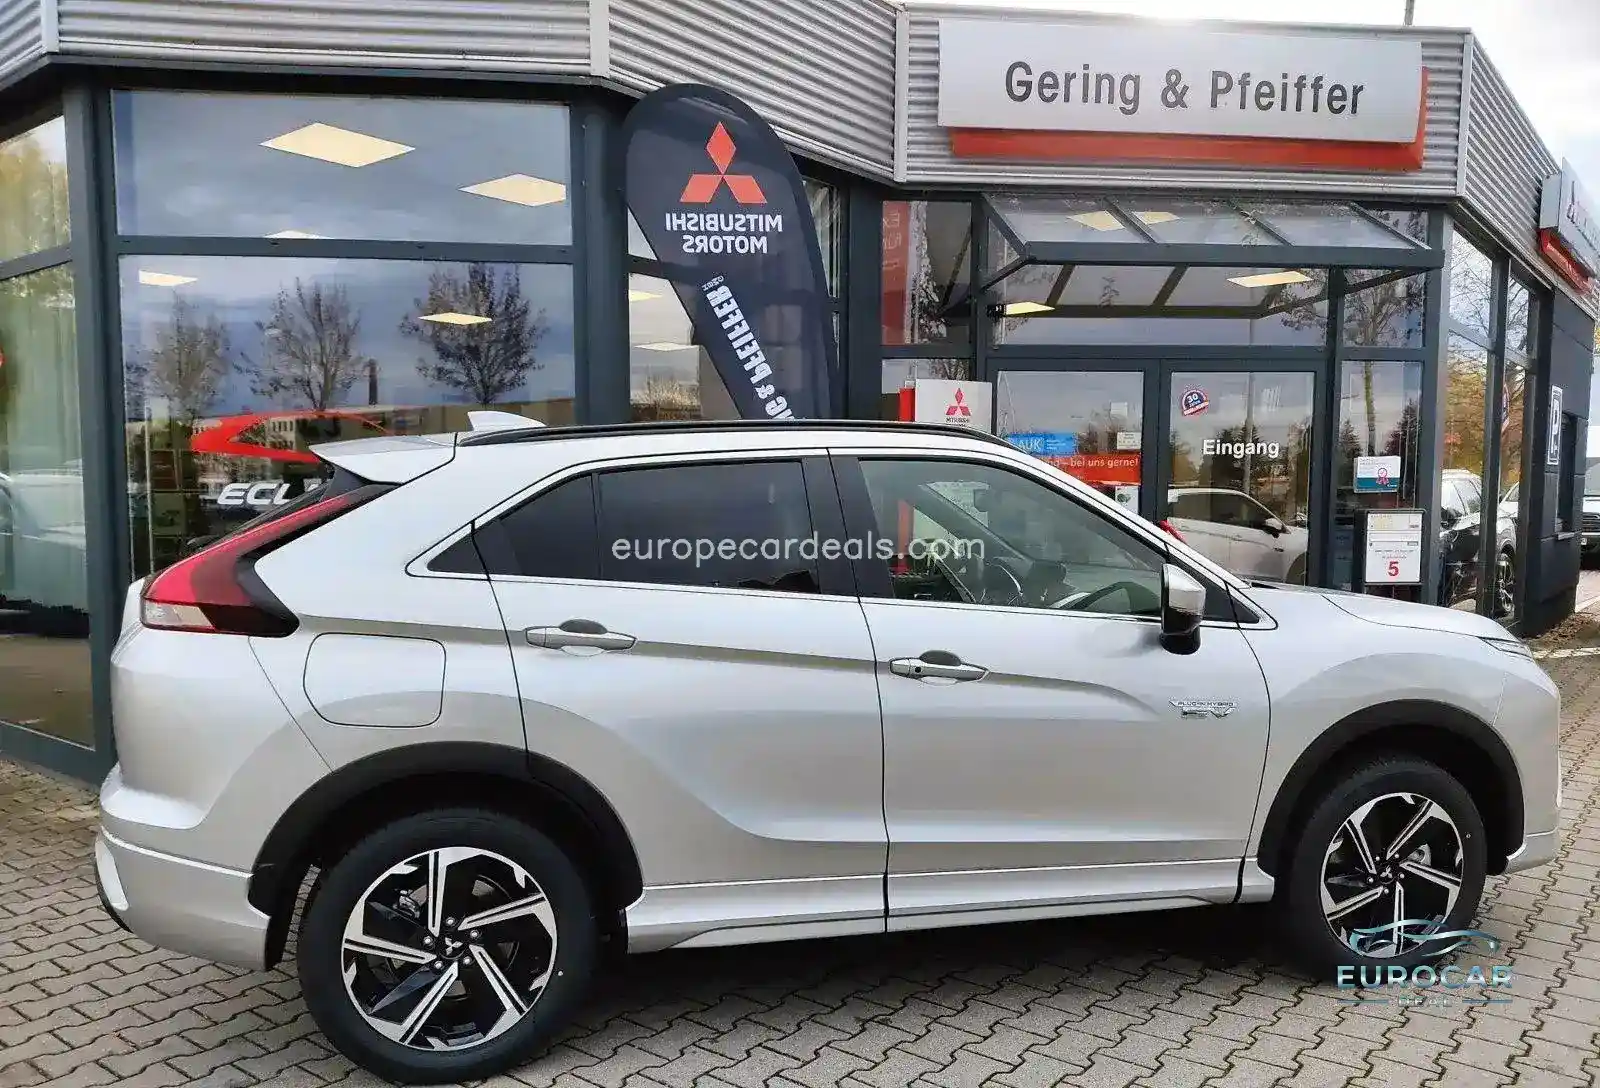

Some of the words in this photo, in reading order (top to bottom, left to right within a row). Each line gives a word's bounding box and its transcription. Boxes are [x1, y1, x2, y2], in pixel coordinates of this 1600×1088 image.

[1005, 61, 1140, 115] Gering
[1161, 69, 1189, 108] &
[1211, 71, 1363, 115] Pfeiffer
[1203, 439, 1280, 459] Eingang
[1107, 458, 1139, 468] gerne!
[1388, 561, 1399, 576] 5
